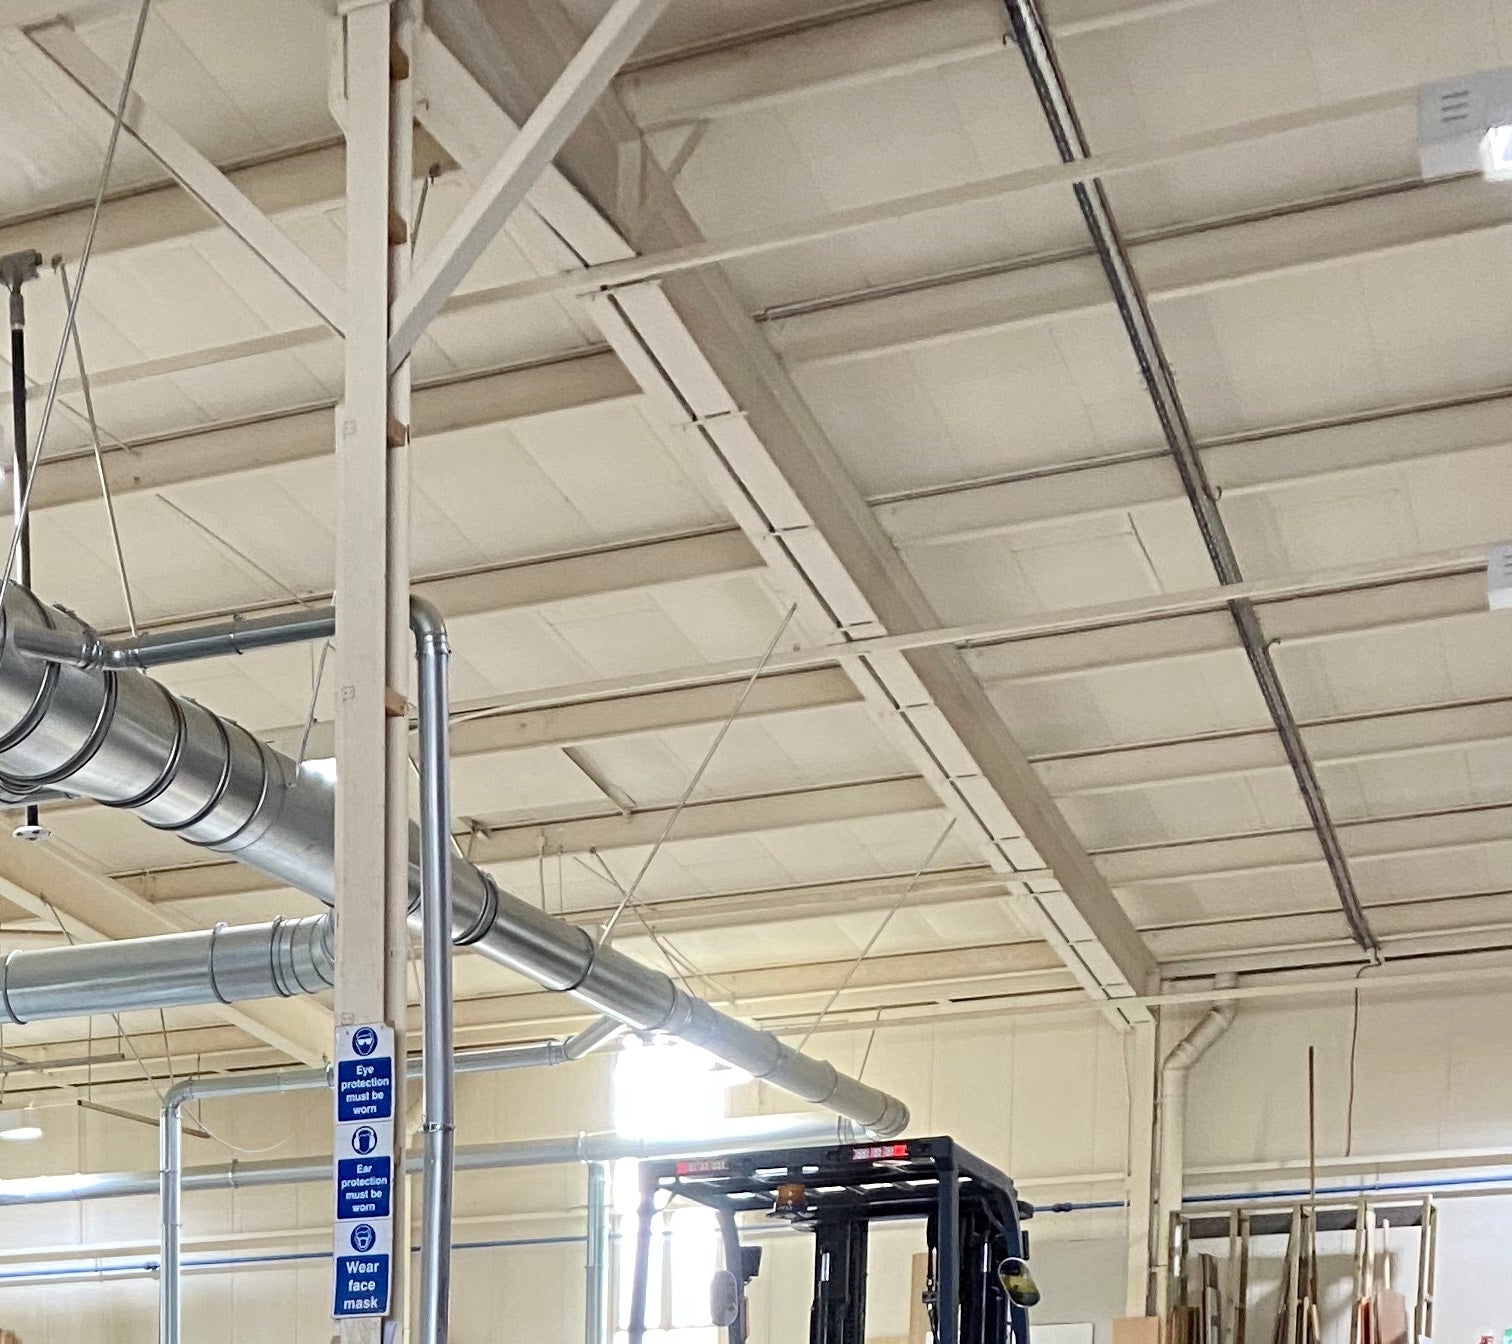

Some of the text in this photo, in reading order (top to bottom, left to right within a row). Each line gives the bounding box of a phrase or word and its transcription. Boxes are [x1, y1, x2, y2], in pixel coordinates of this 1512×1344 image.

[356, 1065, 375, 1077] Eye
[341, 1077, 390, 1092] protection
[346, 1090, 384, 1103] must be
[352, 1105, 377, 1115] worn
[356, 1163, 373, 1174] Ear
[341, 1176, 388, 1190] protection
[345, 1188, 383, 1200] must be
[351, 1203, 376, 1212] worn
[346, 1260, 380, 1274] Wear
[348, 1279, 376, 1292] face
[343, 1295, 378, 1310] mask
